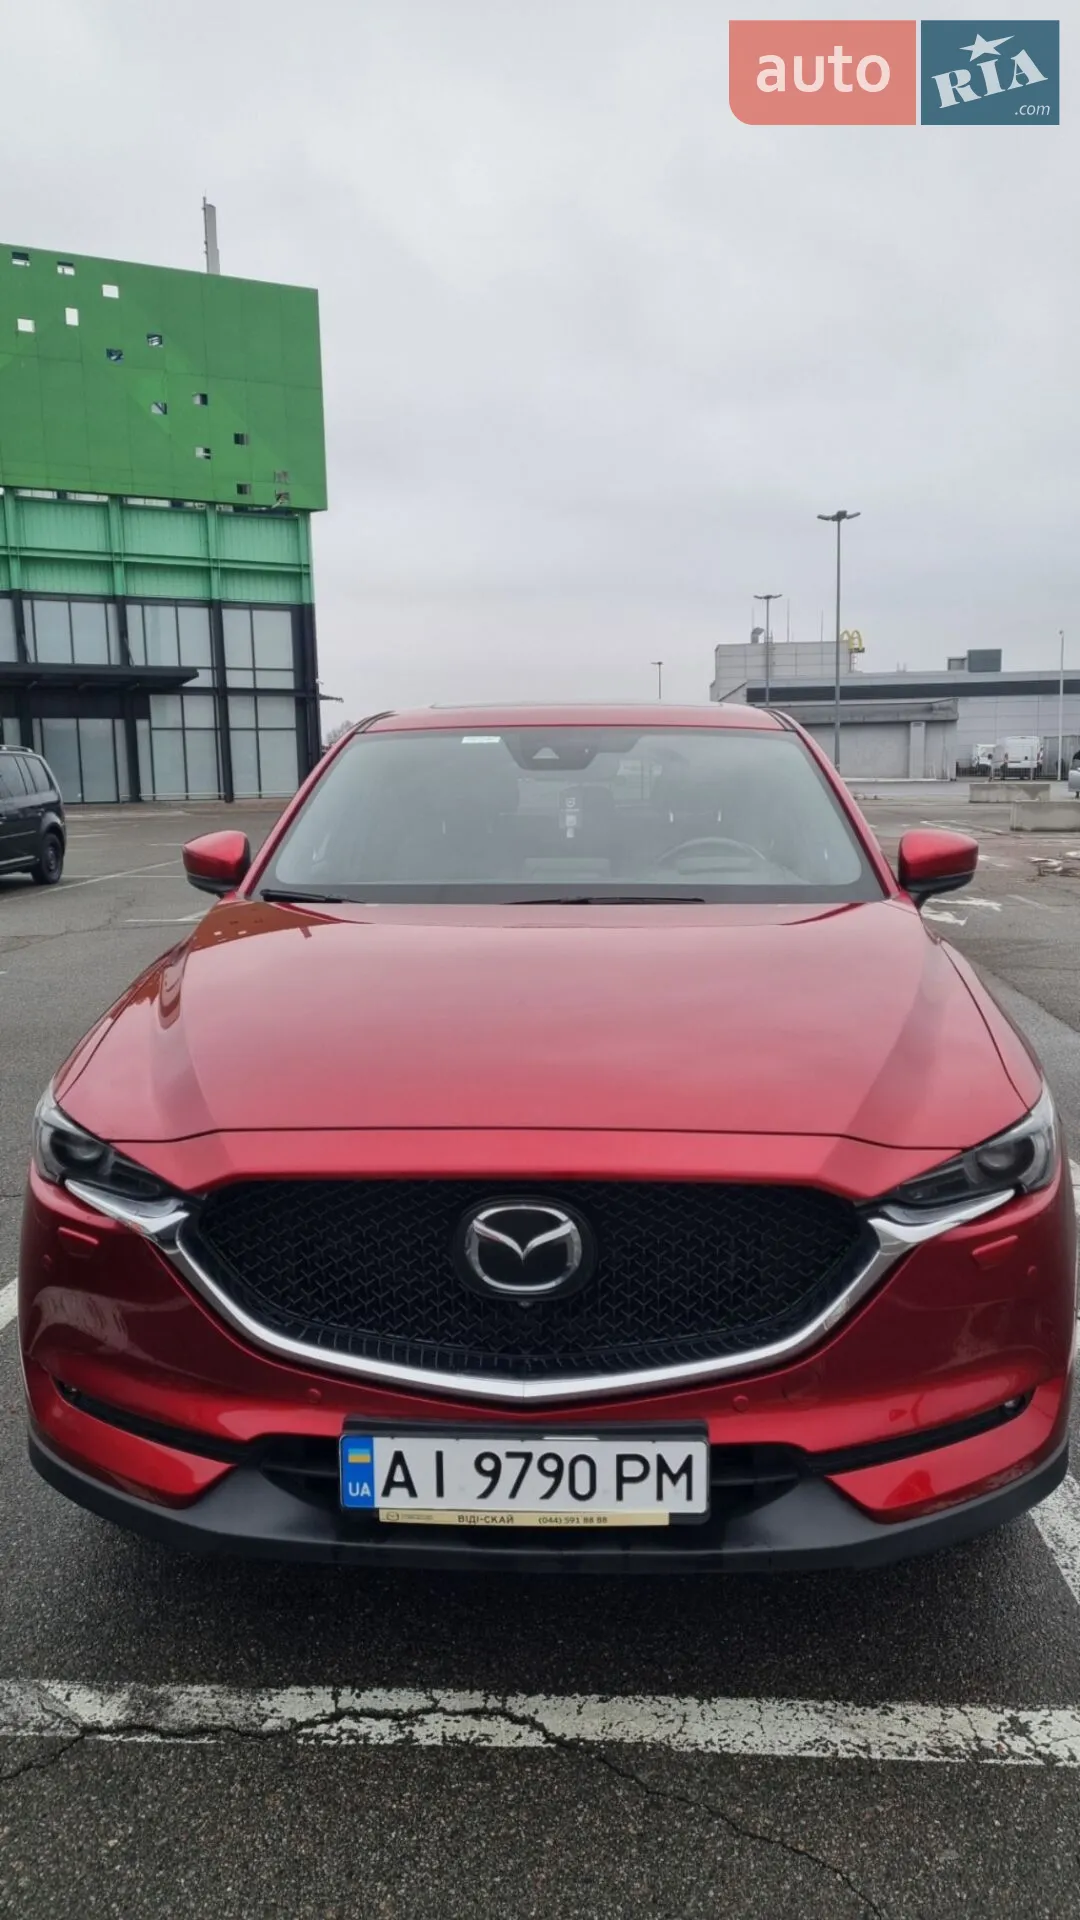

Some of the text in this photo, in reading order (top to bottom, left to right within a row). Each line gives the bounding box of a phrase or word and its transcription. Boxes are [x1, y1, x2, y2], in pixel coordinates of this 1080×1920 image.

[348, 1482, 371, 1497] UA
[381, 1450, 693, 1501] AI 9790 PM
